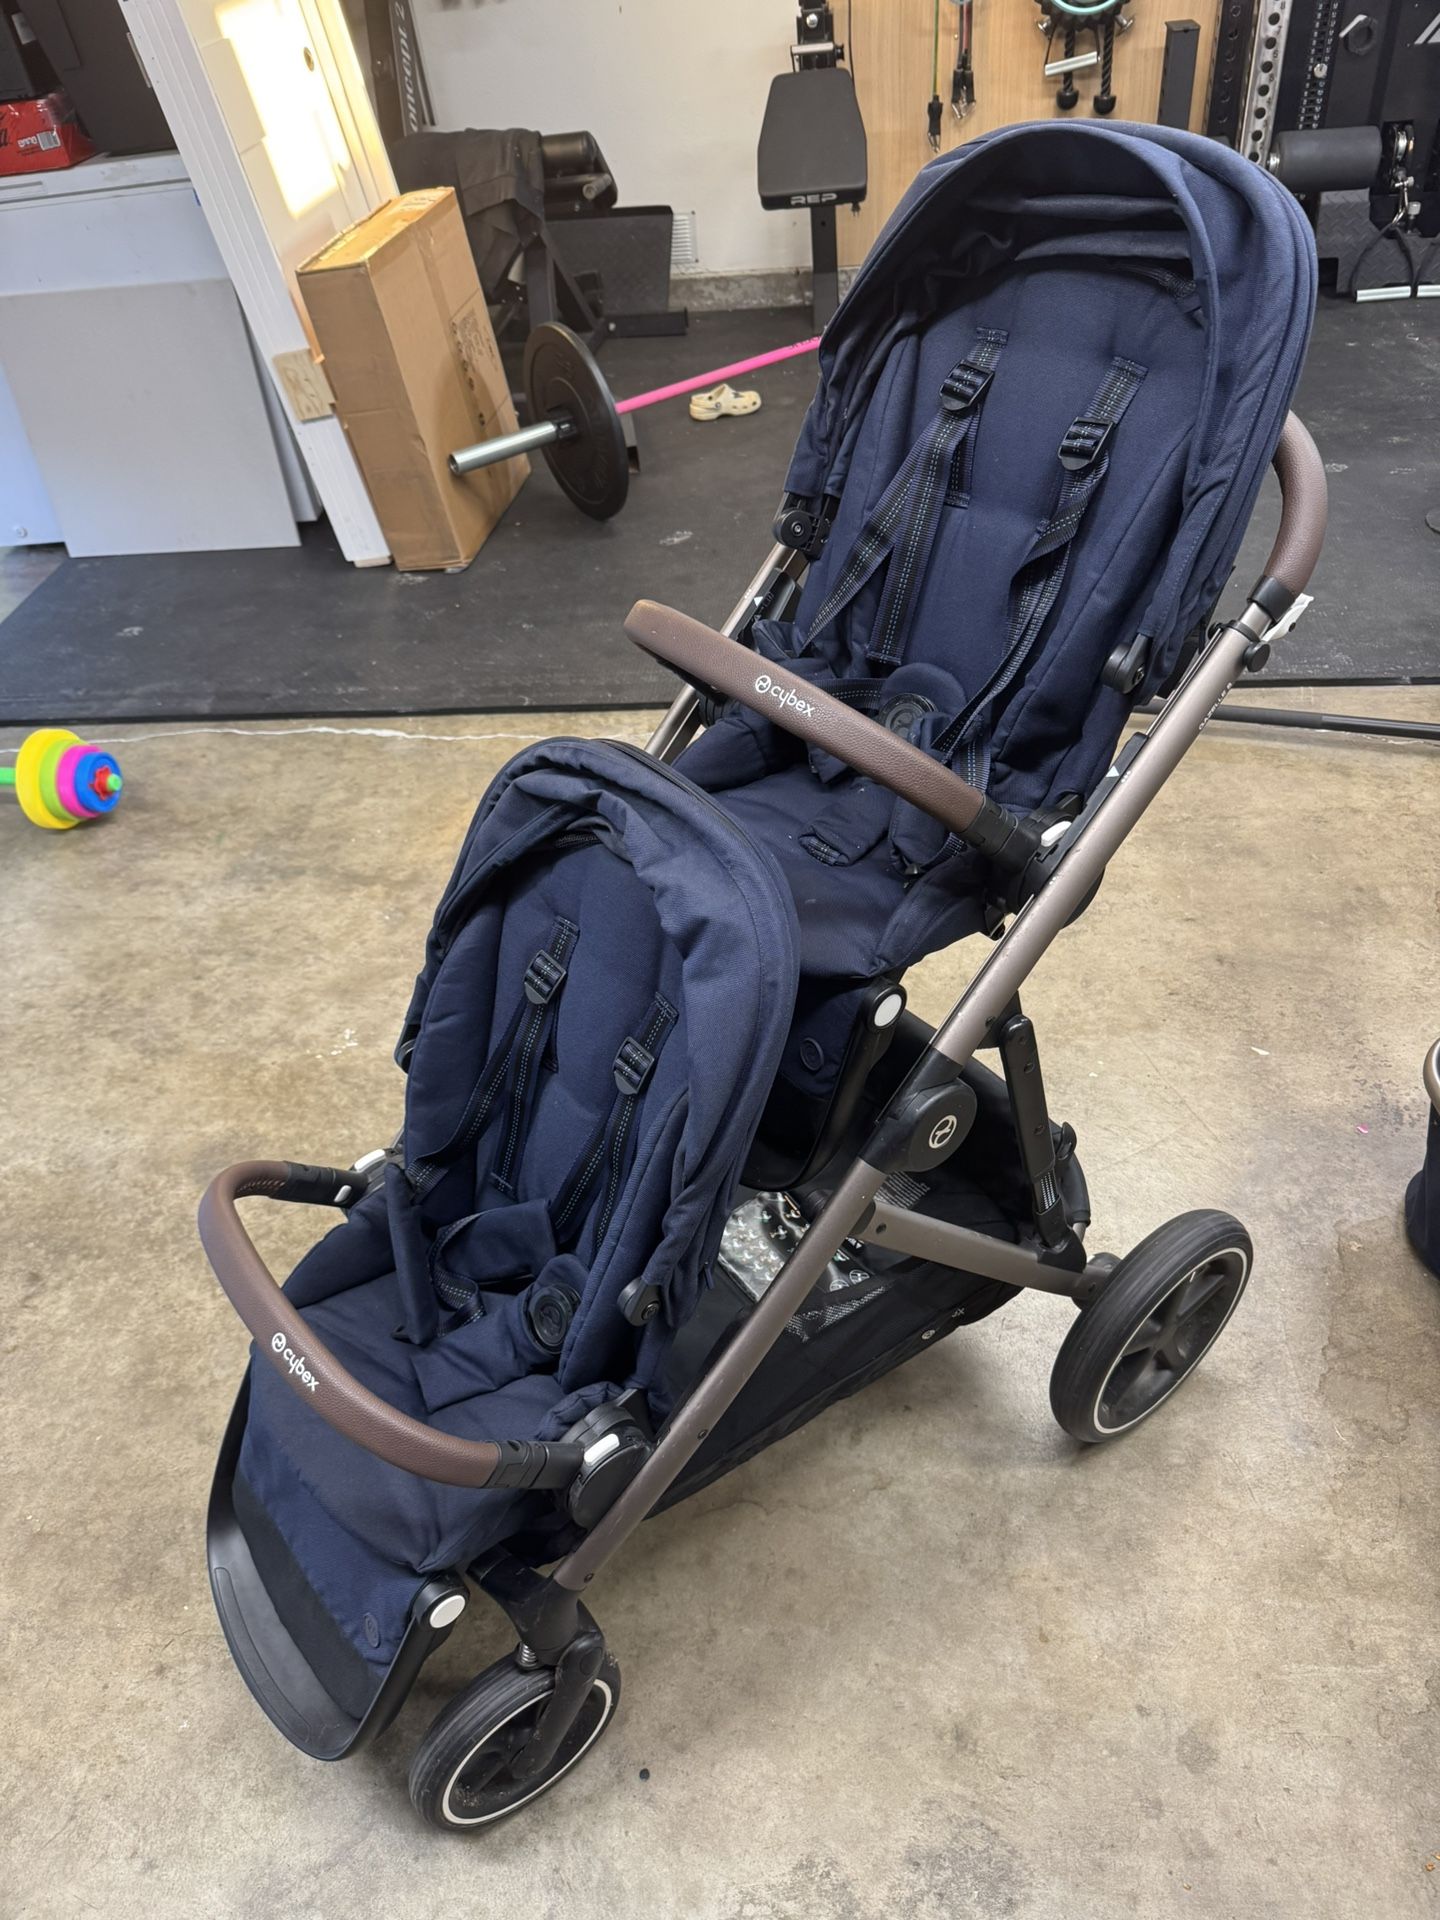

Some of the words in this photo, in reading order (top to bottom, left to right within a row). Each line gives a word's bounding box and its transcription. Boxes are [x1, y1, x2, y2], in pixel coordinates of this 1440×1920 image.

[395, 1, 406, 21] 2
[398, 27, 419, 132] oncept
[790, 192, 838, 206] REP
[771, 685, 816, 717] cybex
[283, 1348, 320, 1392] cybex
